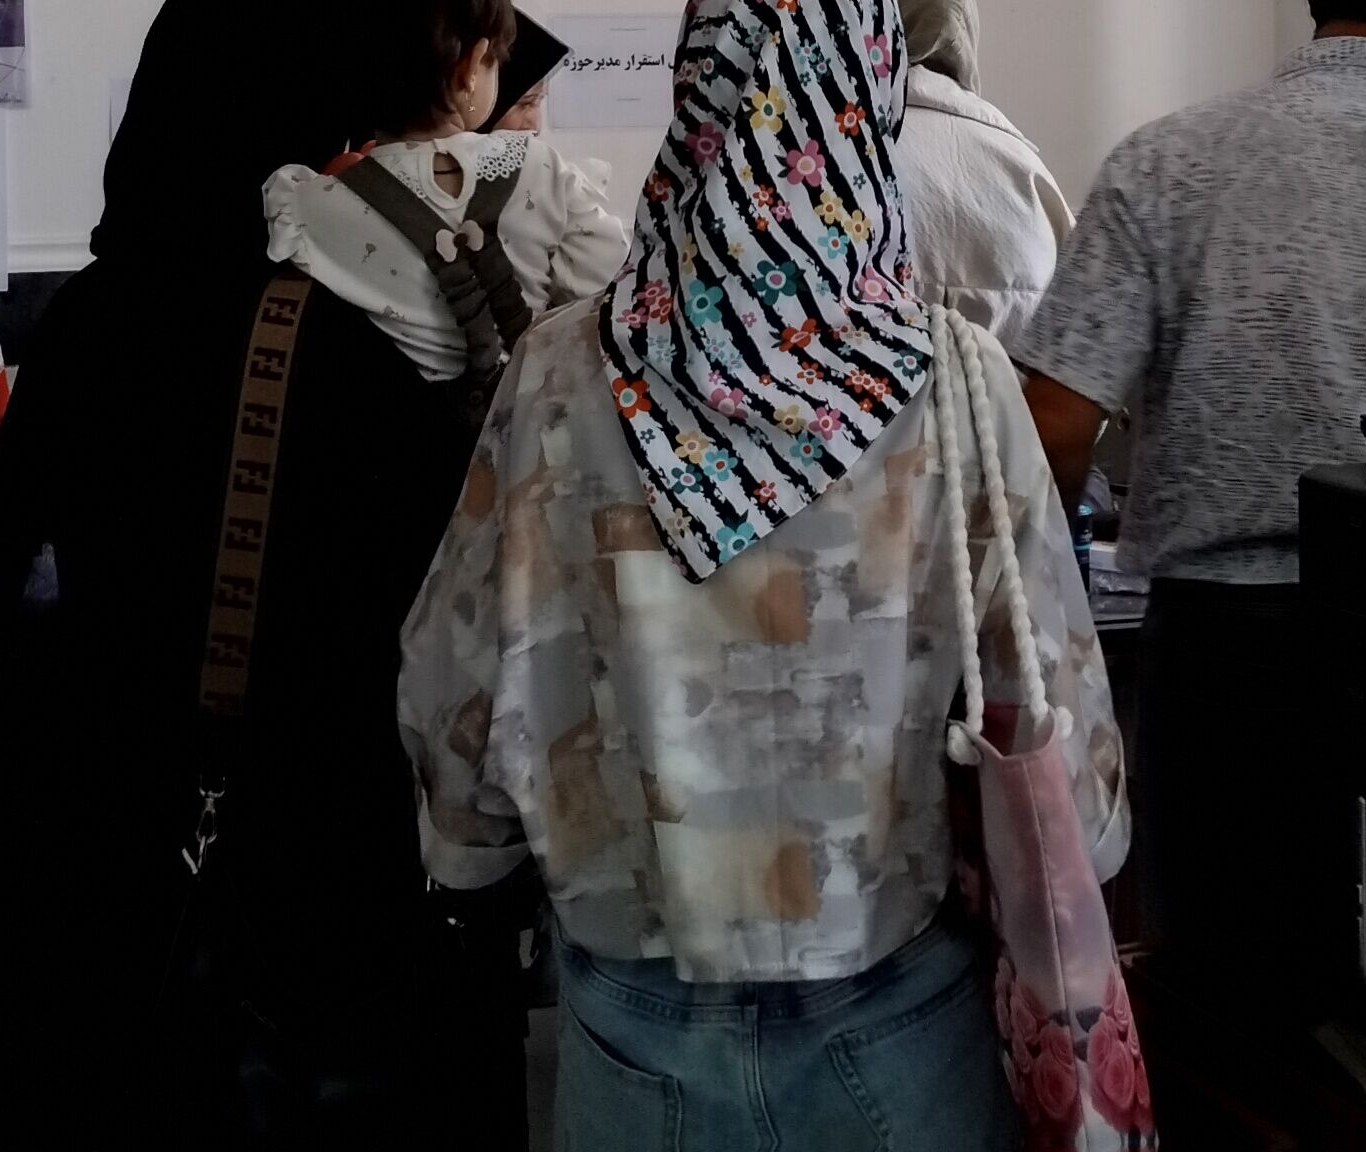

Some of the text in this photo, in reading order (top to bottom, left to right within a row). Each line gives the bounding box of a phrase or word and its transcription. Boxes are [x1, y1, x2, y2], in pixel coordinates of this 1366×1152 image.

[563, 56, 593, 71] حوزه
[592, 57, 621, 71] مدیر
[623, 54, 665, 71] استقرار
